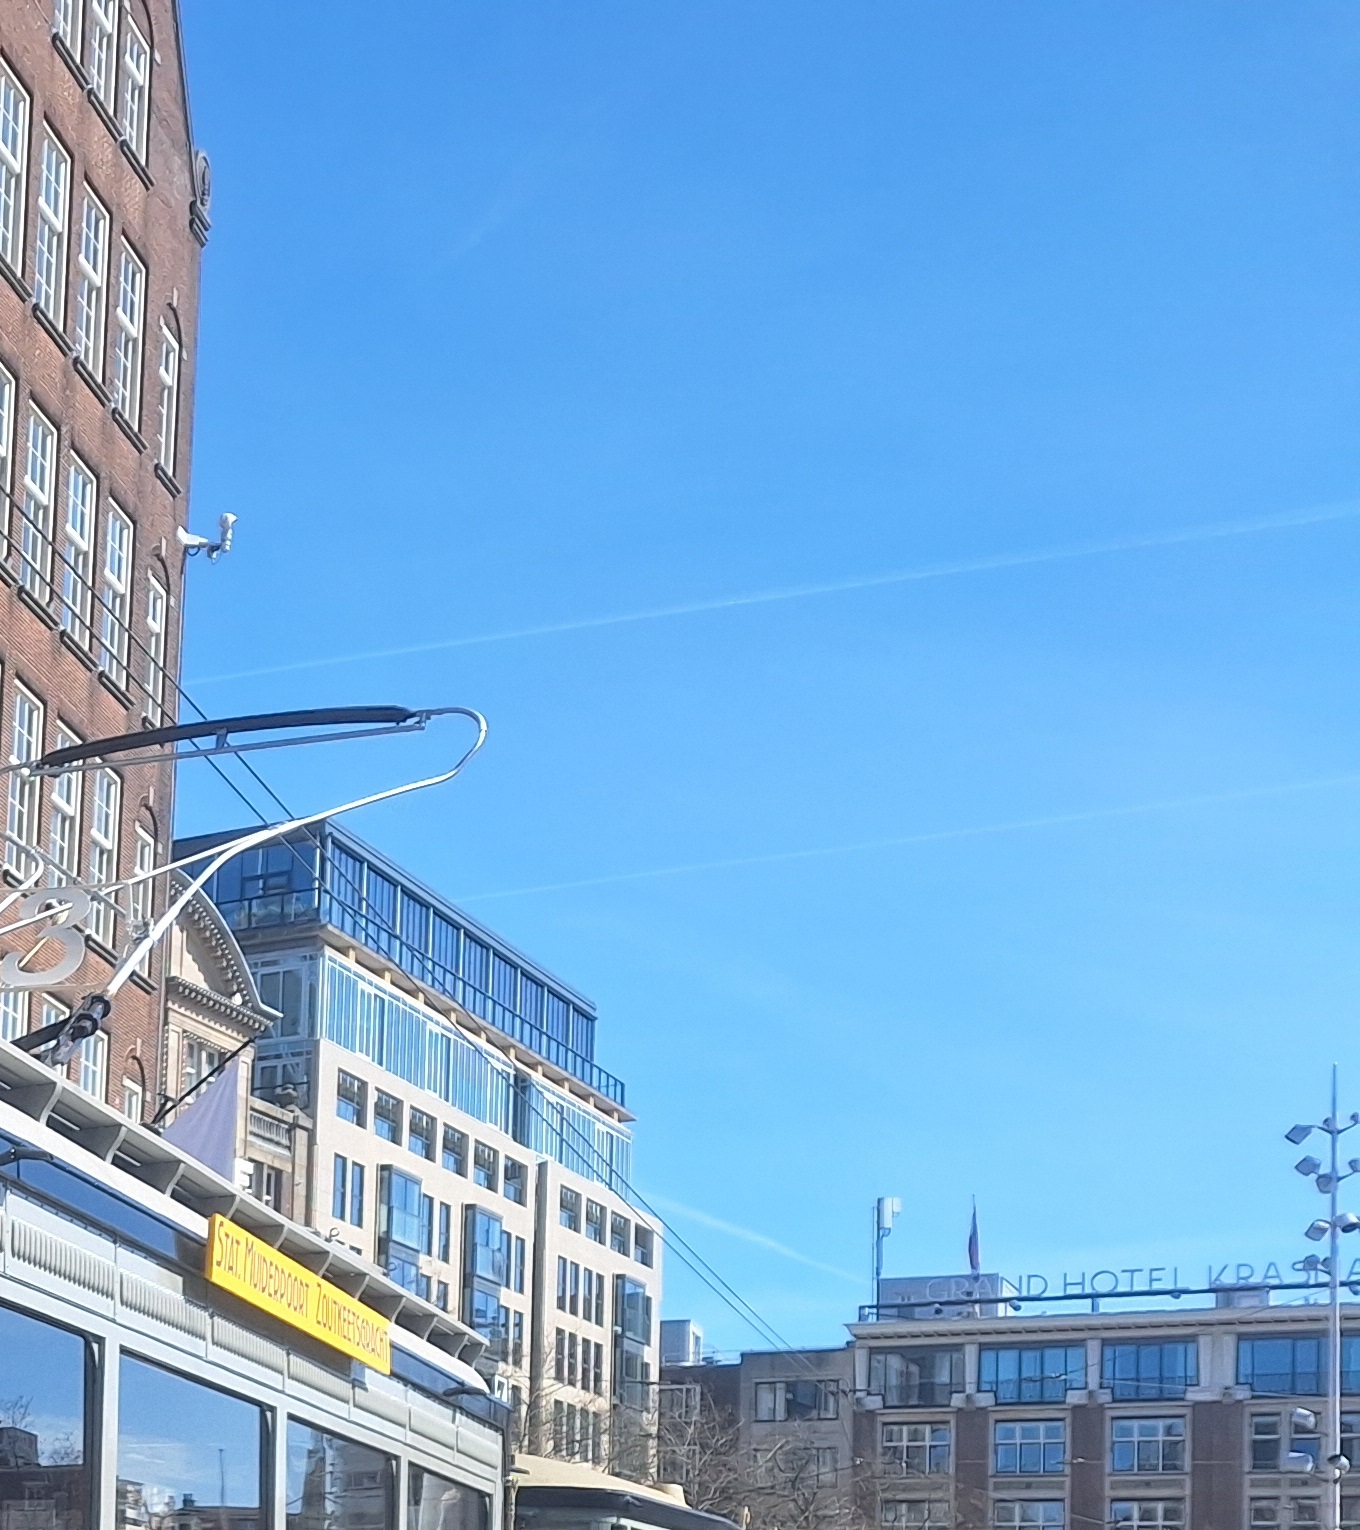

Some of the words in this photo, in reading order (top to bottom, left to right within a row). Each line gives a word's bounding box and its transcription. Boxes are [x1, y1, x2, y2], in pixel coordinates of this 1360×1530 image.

[0, 889, 92, 986] 3
[216, 1221, 241, 1279] STAT.
[243, 1237, 310, 1319] MUIDERPOORT
[926, 1274, 1048, 1299] GRAND
[1063, 1267, 1183, 1296] HOTEL
